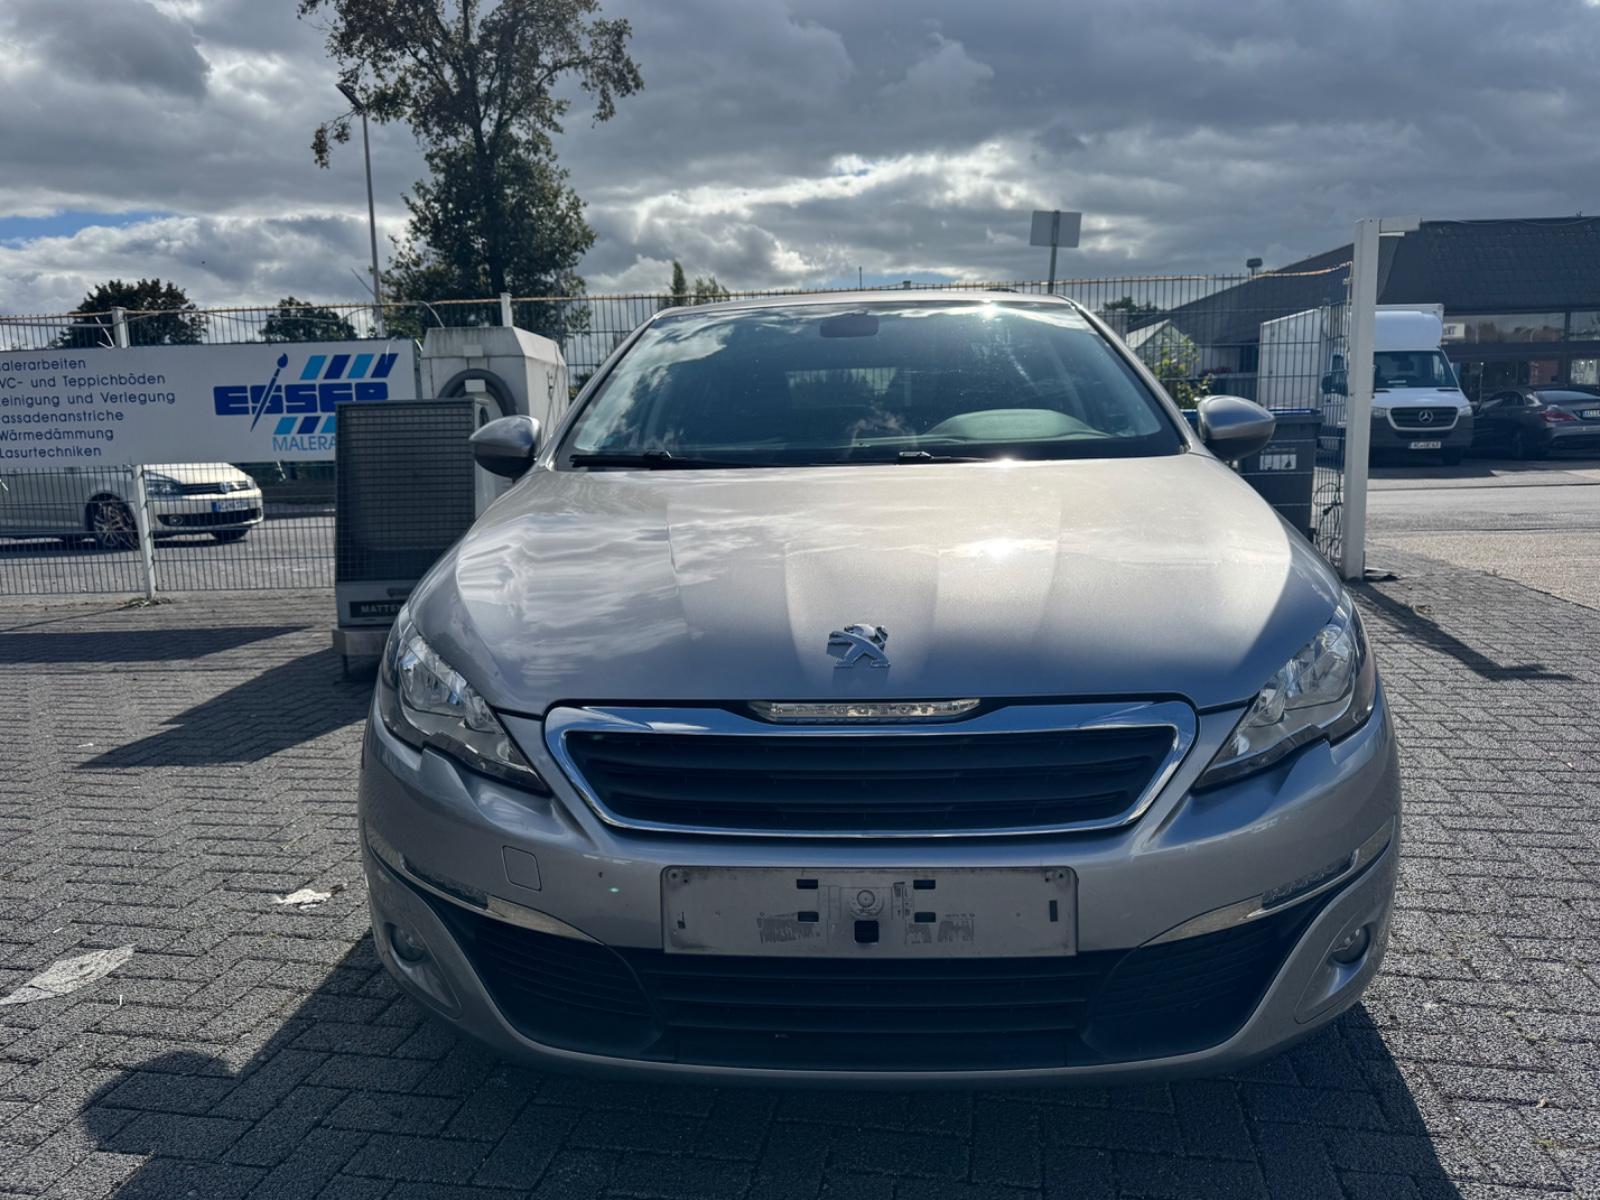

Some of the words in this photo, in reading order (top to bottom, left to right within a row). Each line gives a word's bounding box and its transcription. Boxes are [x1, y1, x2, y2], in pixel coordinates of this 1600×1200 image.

[0, 358, 86, 372] alerarbeiten
[31, 376, 56, 388] und
[63, 373, 166, 389] Teppichböden
[0, 393, 60, 408] einigung
[67, 393, 94, 405] und
[100, 389, 176, 405] Verlegung
[0, 428, 114, 442] Wärmedämmung
[0, 445, 102, 459] Lasurtechniken
